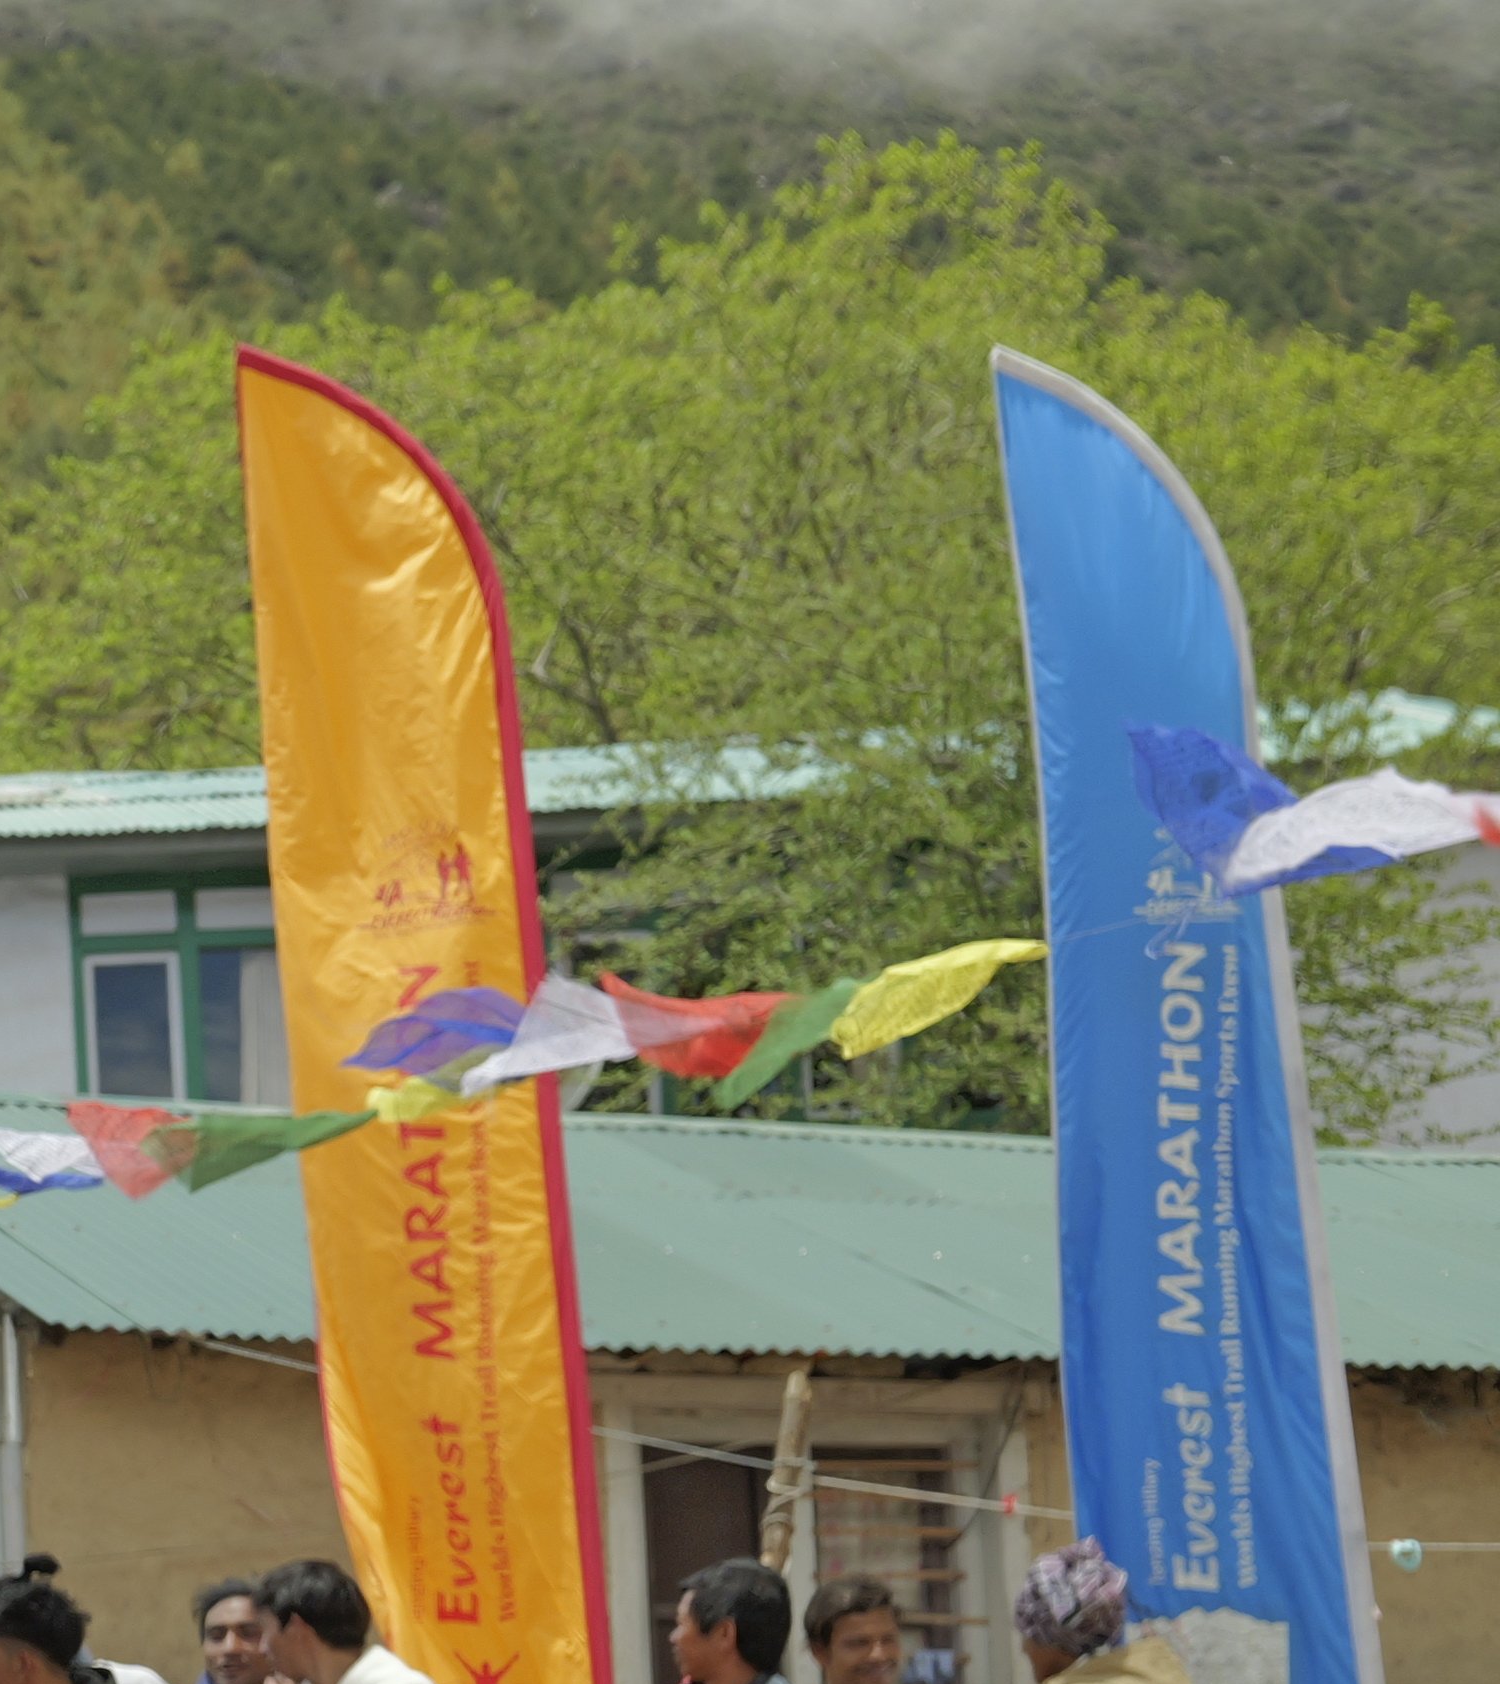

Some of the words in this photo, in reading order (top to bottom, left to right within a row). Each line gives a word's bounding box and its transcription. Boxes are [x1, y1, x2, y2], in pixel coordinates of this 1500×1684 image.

[1155, 941, 1208, 1337] MARATHON
[1211, 1102, 1237, 1226] Marathon
[1215, 1228, 1242, 1336] Running
[1219, 1339, 1246, 1395] Trail
[1161, 1382, 1222, 1594] Everest
[1225, 1400, 1253, 1496] Highest
[419, 1414, 481, 1627] Everest
